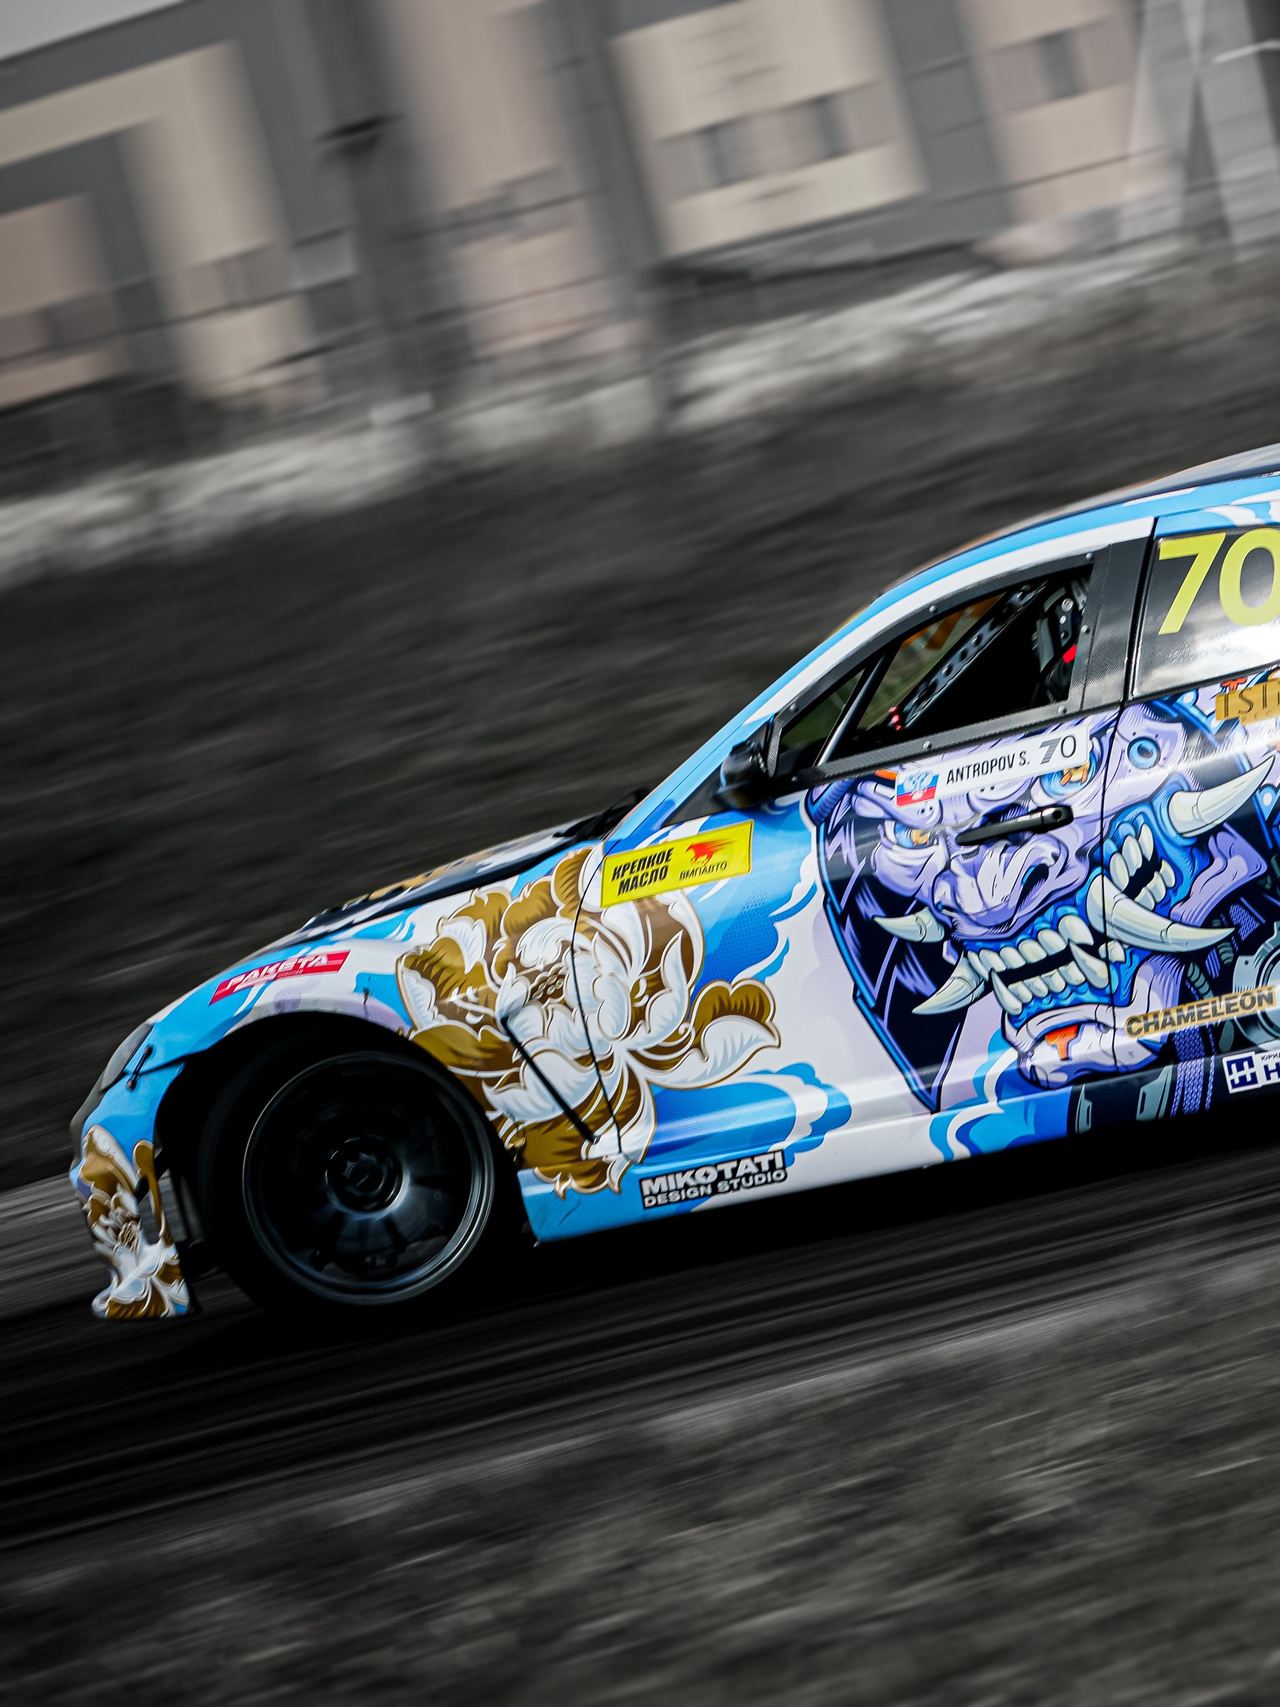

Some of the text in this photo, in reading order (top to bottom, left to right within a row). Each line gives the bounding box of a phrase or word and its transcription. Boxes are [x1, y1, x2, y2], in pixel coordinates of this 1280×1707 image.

[946, 734, 1077, 786] ANTROPOV S. 70
[611, 847, 675, 882] КРЕПКОЕ
[617, 865, 669, 896] МАСЛО
[1125, 990, 1274, 1037] CHAMELEON
[641, 1150, 785, 1197] MIKOTATI
[644, 1169, 786, 1208] DESIGN STUDIO
